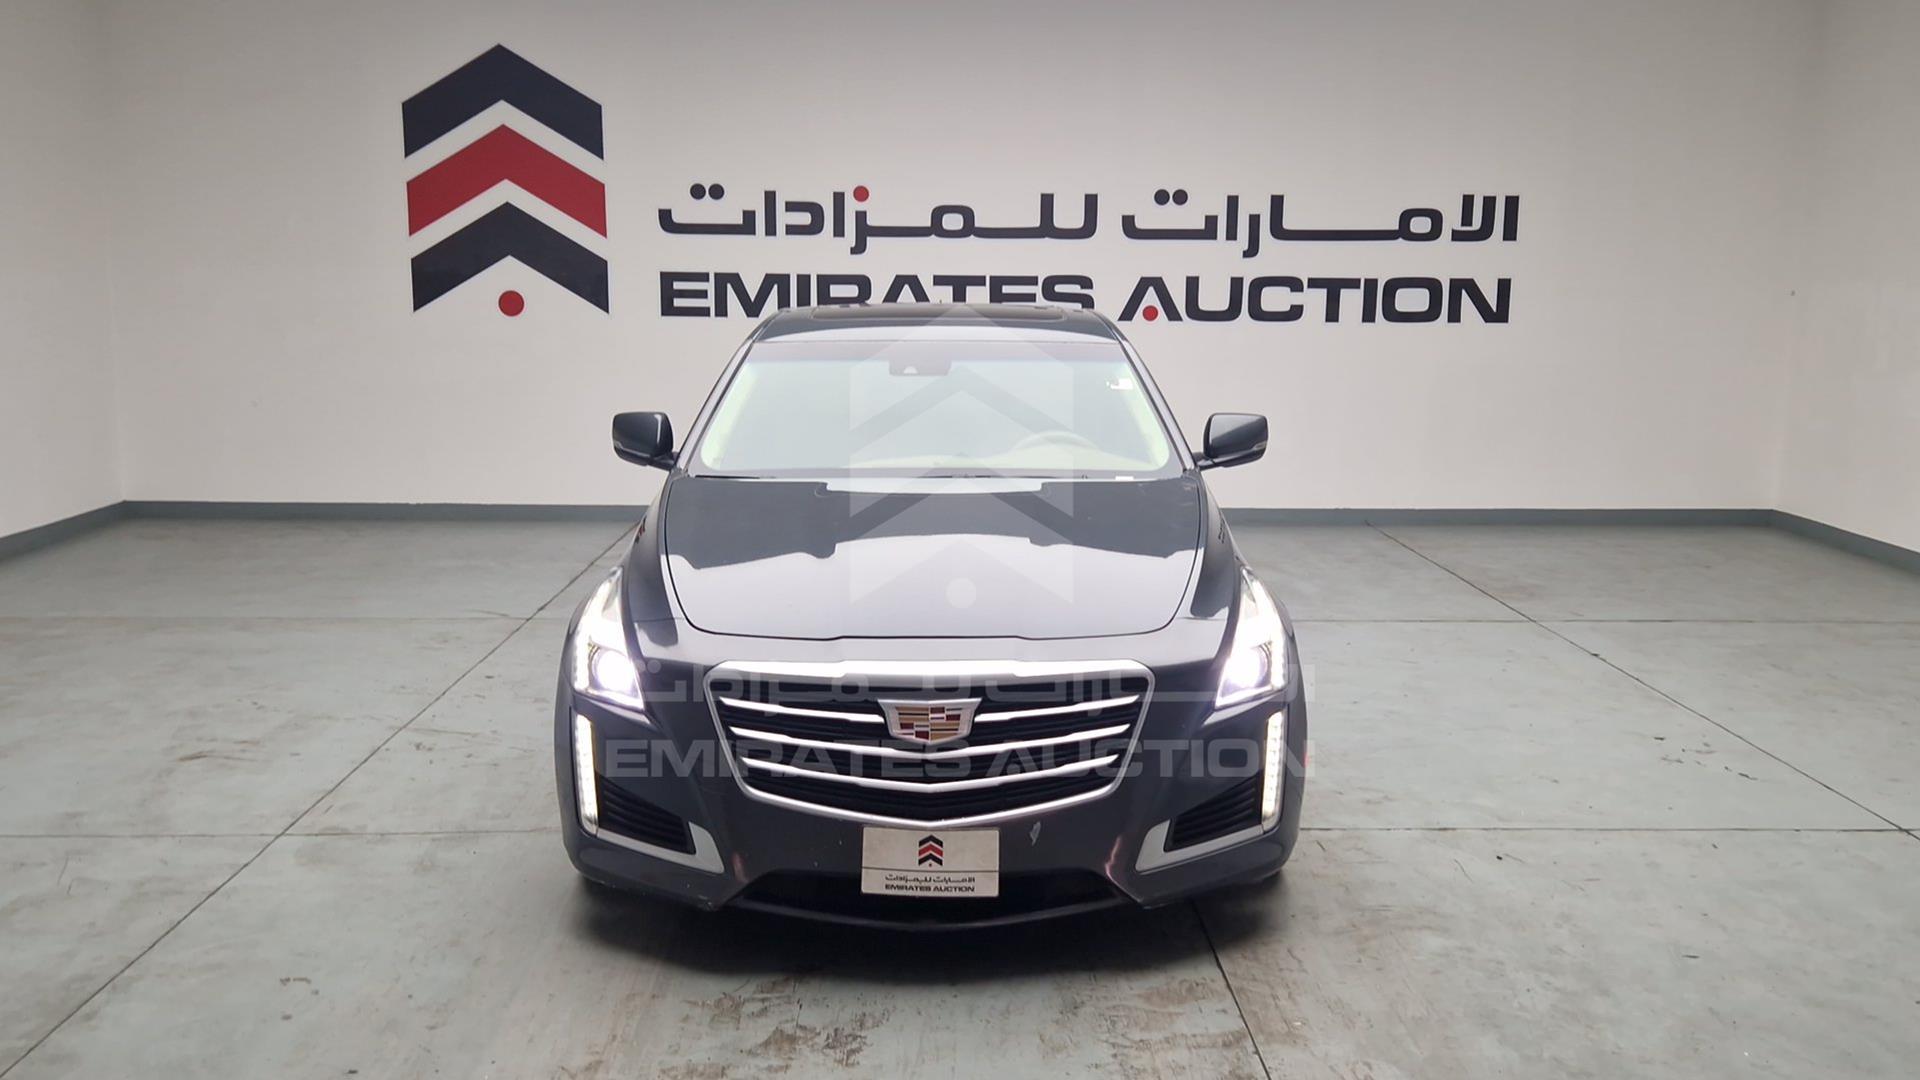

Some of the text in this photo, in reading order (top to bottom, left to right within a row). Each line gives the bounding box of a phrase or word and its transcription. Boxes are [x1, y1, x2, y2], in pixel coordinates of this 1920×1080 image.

[658, 183, 1520, 258] الامارات للمزادات
[1118, 275, 1512, 323] AUCTION
[885, 884, 931, 892] EMIRATES
